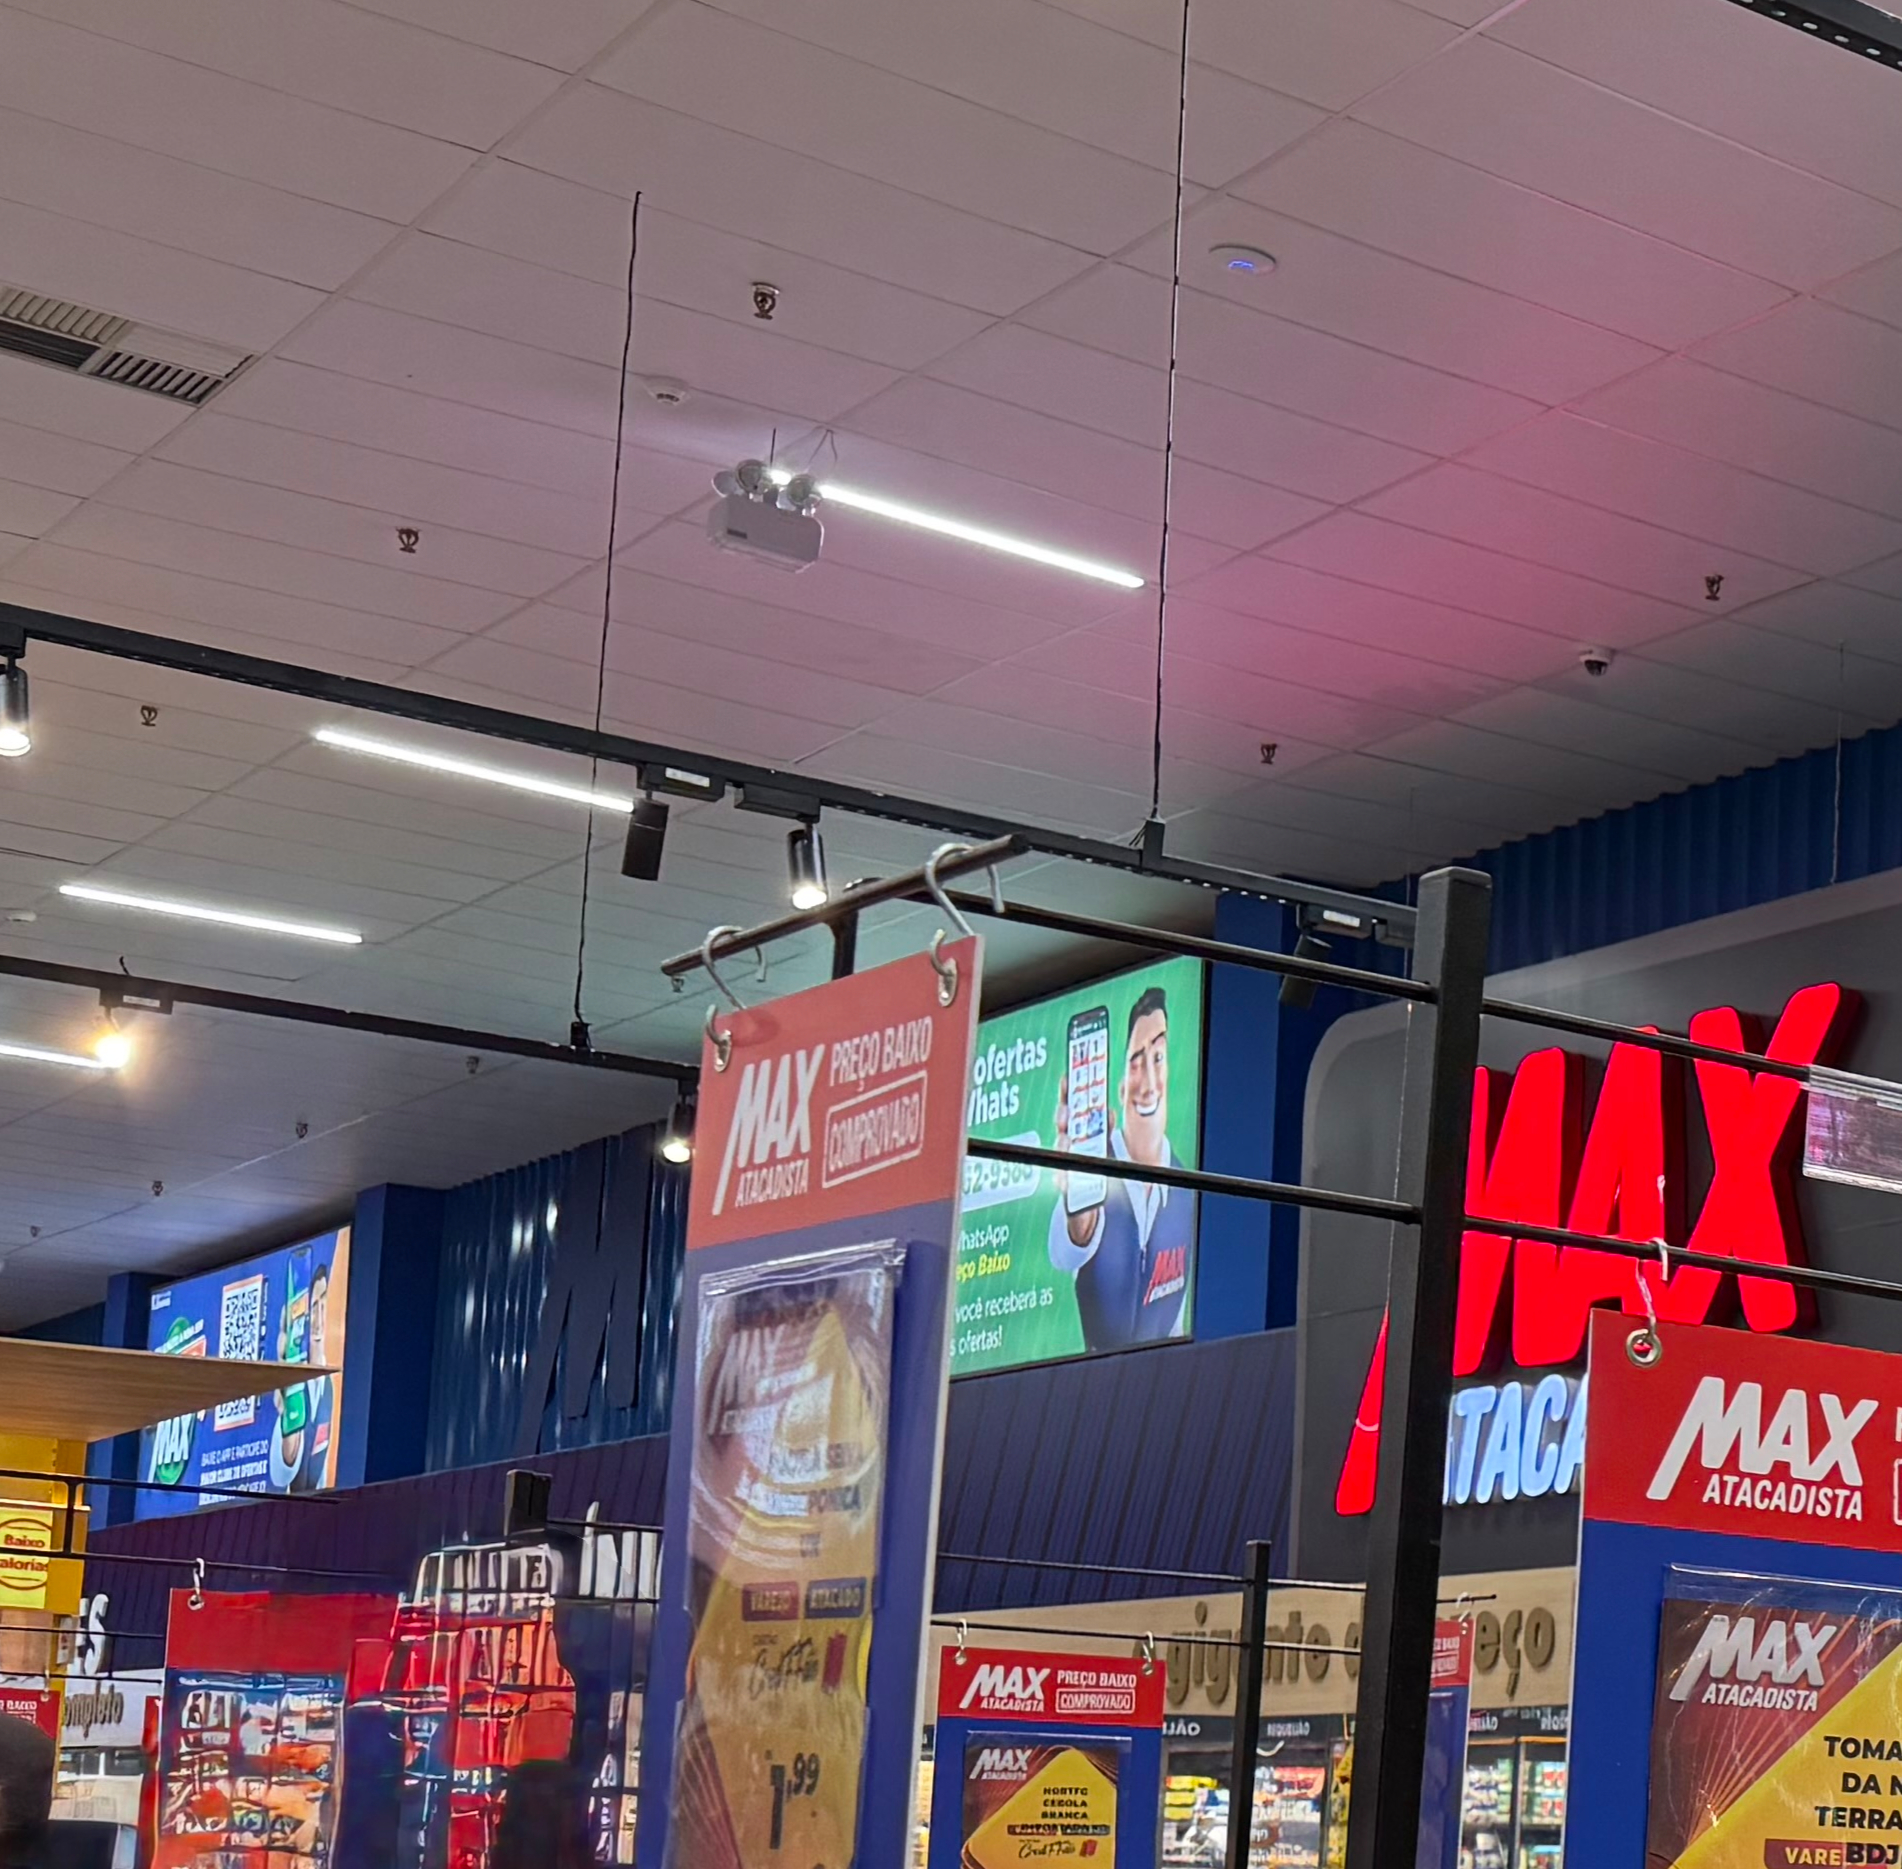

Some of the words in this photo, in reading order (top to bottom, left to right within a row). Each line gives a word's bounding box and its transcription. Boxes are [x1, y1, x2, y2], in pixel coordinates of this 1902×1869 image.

[831, 1032, 880, 1093] PREÇO
[881, 1016, 932, 1066] BAIXO
[974, 1036, 1047, 1084] ofertas
[712, 1042, 826, 1215] MAX
[827, 1090, 920, 1175] COMPROVADO
[735, 1158, 809, 1208] ATACADISTA
[980, 1252, 1010, 1280] Baixo
[1336, 982, 1842, 1515] MAX
[1646, 1376, 1879, 1500] MAX
[1703, 1474, 1863, 1522] ATACADISTA
[0, 1557, 48, 1572] alorias
[4, 1534, 45, 1549] Baixo
[1166, 1600, 1332, 1705] gignte
[1670, 1614, 1837, 1701] MAX
[959, 1664, 1051, 1709] MAX
[1057, 1670, 1097, 1688] PREÇO
[1100, 1672, 1136, 1688] BAIXO
[1060, 1693, 1132, 1710] COMPROVADO
[1702, 1683, 1818, 1711] ATACADISTA
[980, 1698, 1044, 1713] ATACADISTA
[969, 1748, 1032, 1780] MAX
[1842, 1772, 1880, 1795] DA
[769, 1752, 821, 1851] 1,99
[1846, 1842, 1899, 1866] BDJ
